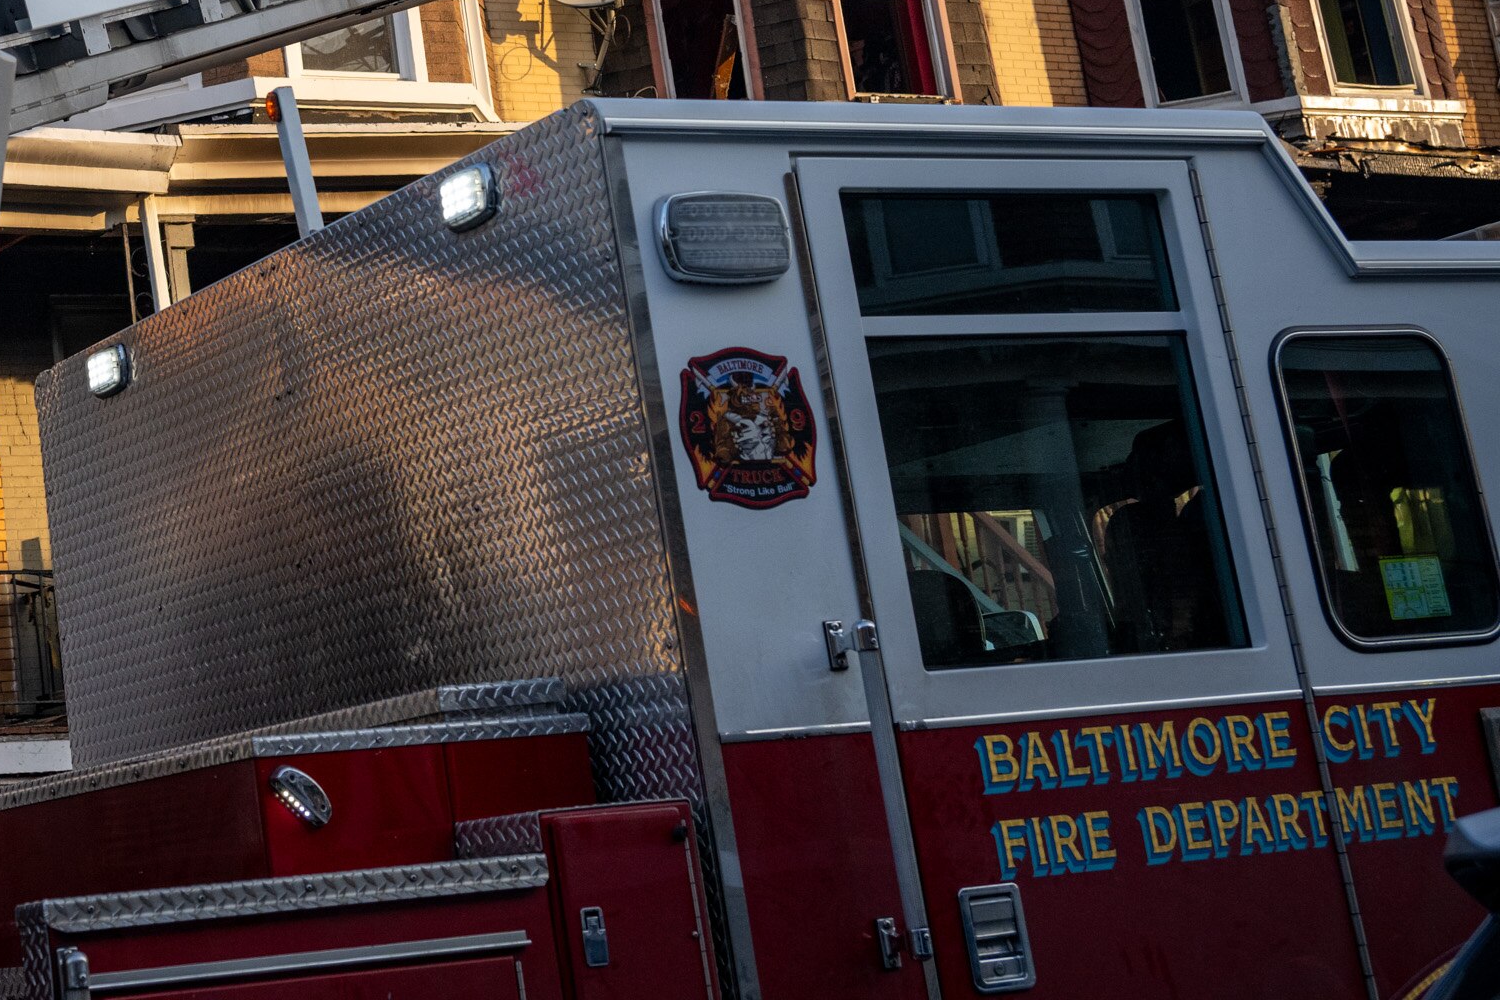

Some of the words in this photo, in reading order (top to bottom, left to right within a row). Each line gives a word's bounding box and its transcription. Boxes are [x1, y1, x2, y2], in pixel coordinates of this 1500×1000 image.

[716, 359, 764, 375] BALTIMORE
[690, 411, 706, 434] 2
[790, 409, 806, 431] 9
[731, 468, 785, 485] TRUCK
[757, 486, 776, 495] Like
[975, 711, 1297, 794] BALTIMORE
[1321, 698, 1437, 763] CITY
[991, 811, 1117, 880] FIRE
[1137, 776, 1459, 865] DEPARTMENT
